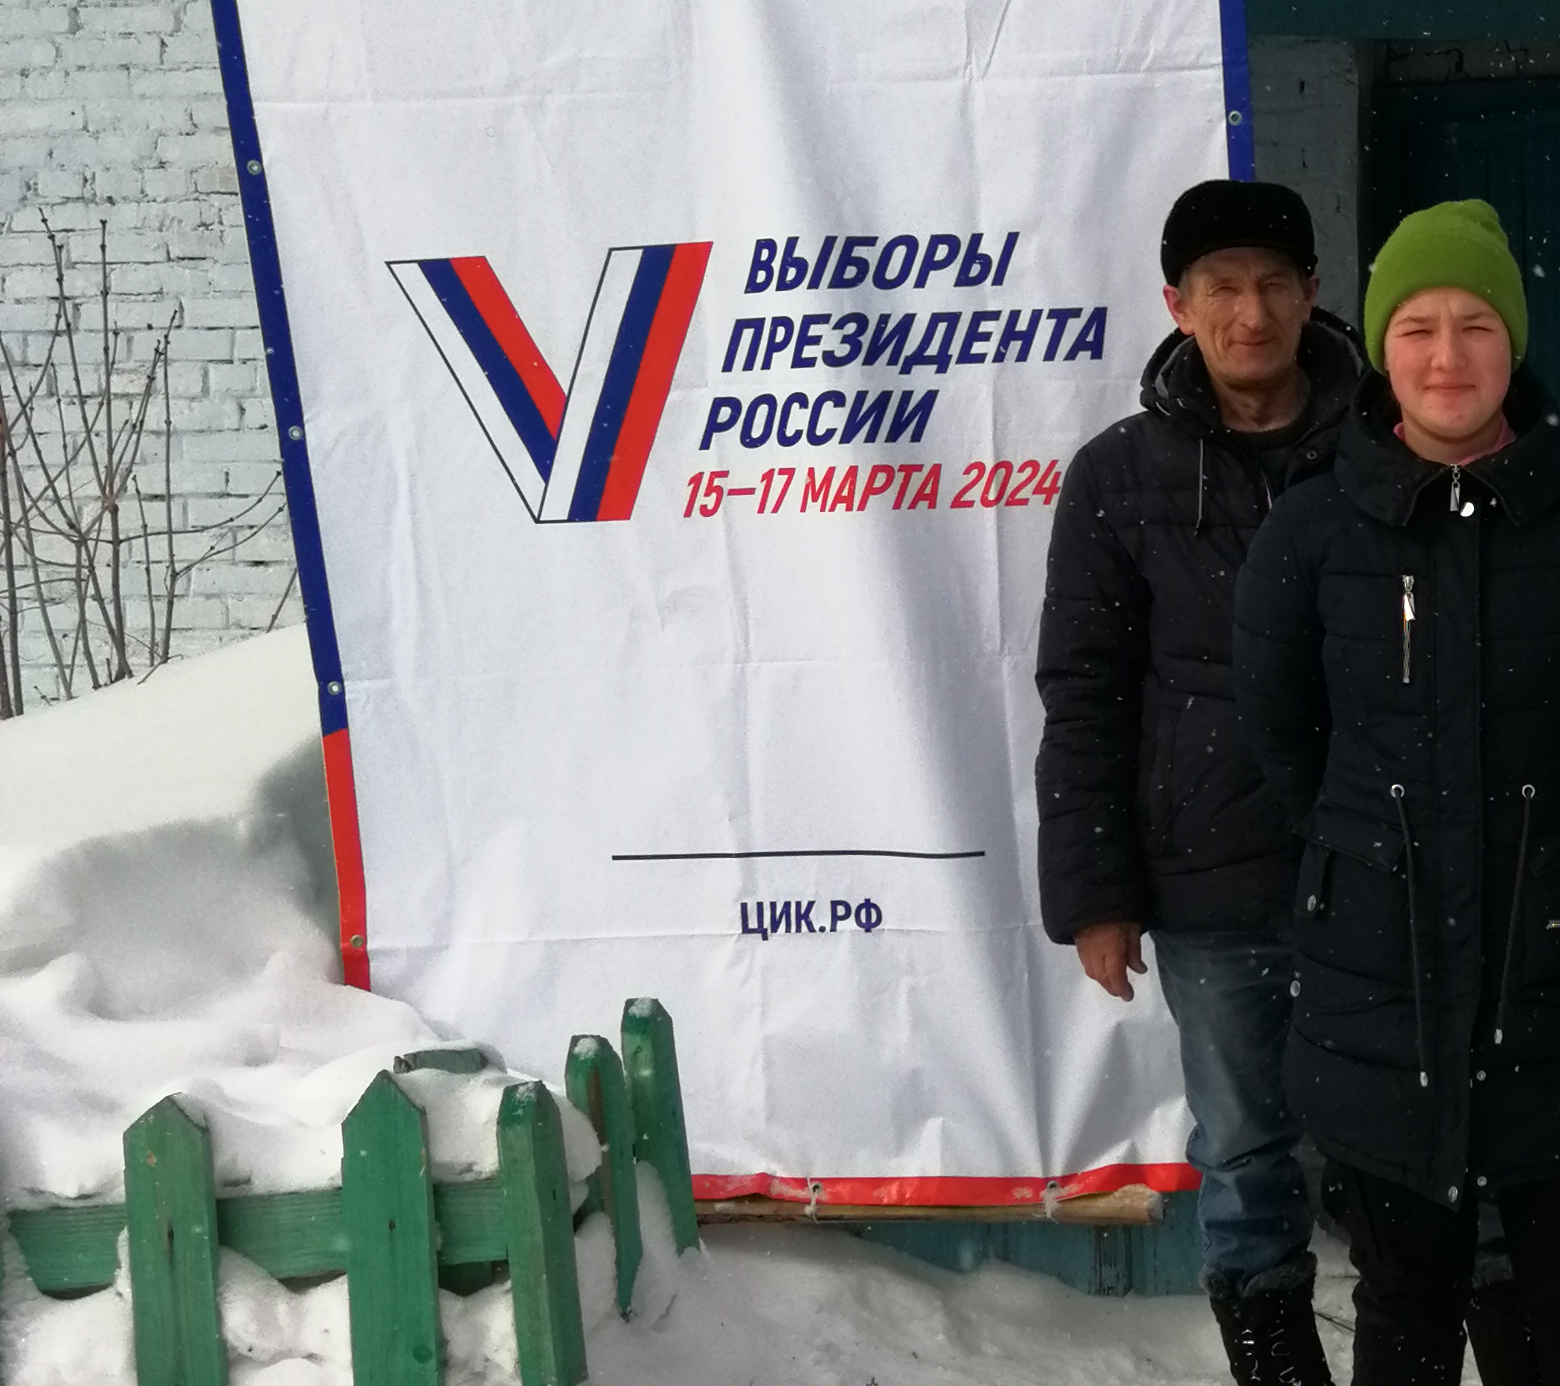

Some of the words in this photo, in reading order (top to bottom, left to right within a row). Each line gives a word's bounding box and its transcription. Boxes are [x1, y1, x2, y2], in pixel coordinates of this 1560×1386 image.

[744, 231, 1020, 294] ВЫБОРЫ
[721, 306, 1108, 375] ПРЕЗИДЕНТА
[698, 389, 939, 451] РОССИИ
[800, 463, 934, 513] МАРТА
[950, 459, 1061, 509] 2024
[740, 898, 883, 942] ЦИК.РФ
